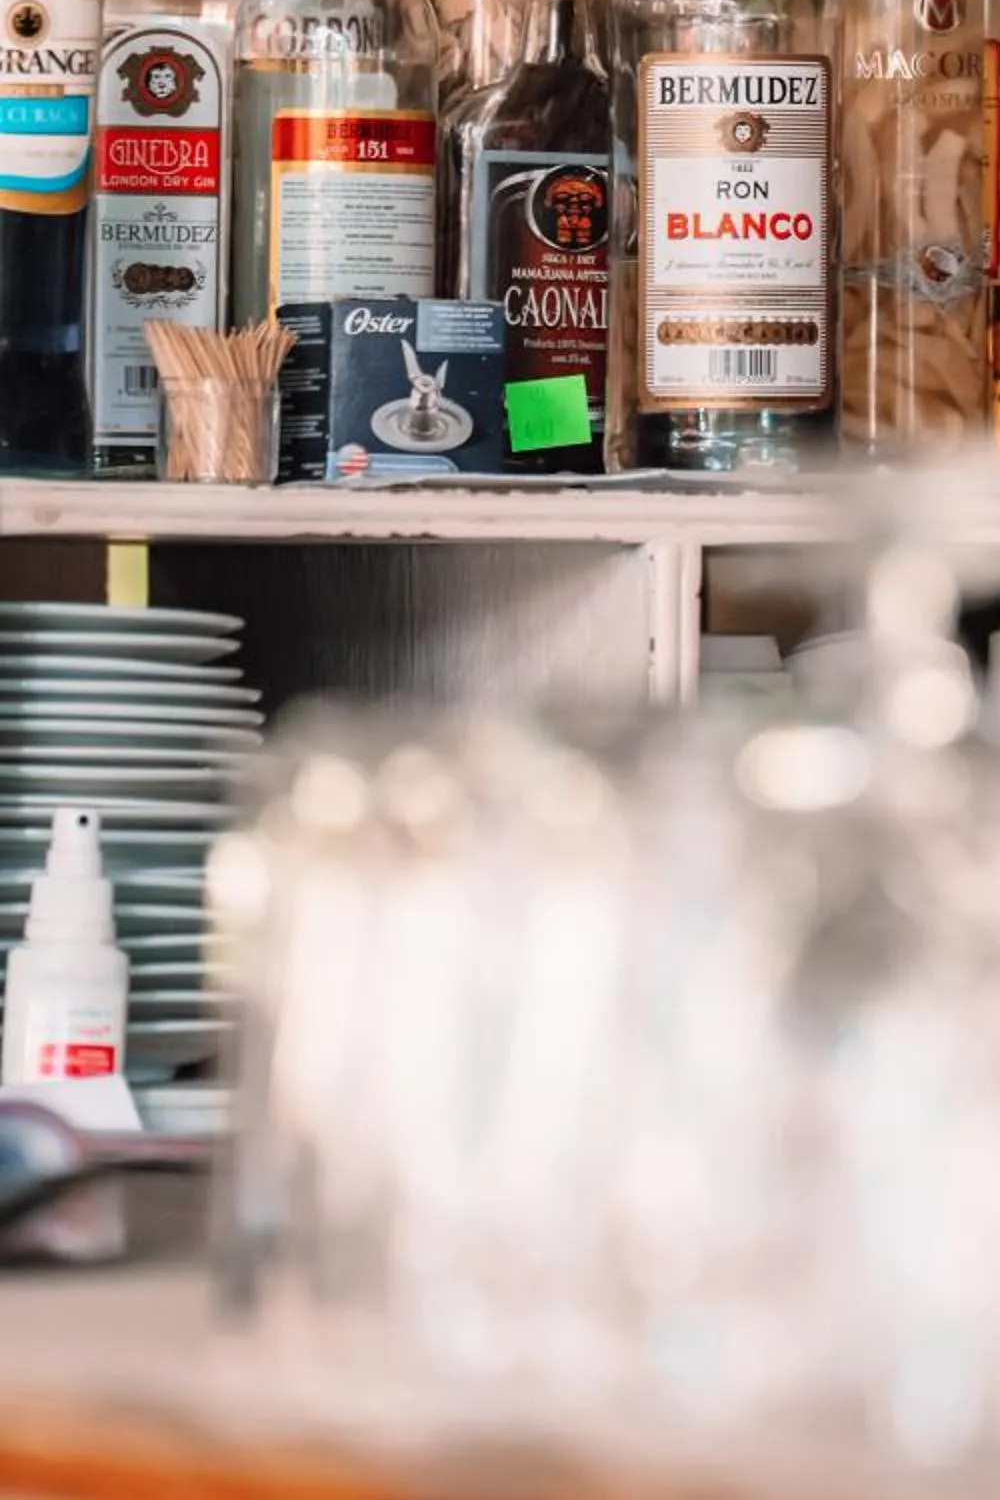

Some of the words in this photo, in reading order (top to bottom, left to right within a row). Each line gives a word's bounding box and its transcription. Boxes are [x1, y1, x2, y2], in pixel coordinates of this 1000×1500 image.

[659, 74, 819, 106] BERMUDEZ
[109, 138, 210, 175] GINEBRA
[356, 139, 390, 160] 151
[100, 172, 158, 188] LONDON
[716, 180, 770, 200] RON
[101, 222, 216, 243] BERMUDEZ
[666, 212, 813, 241] BLANCO
[343, 307, 415, 336] Oster
